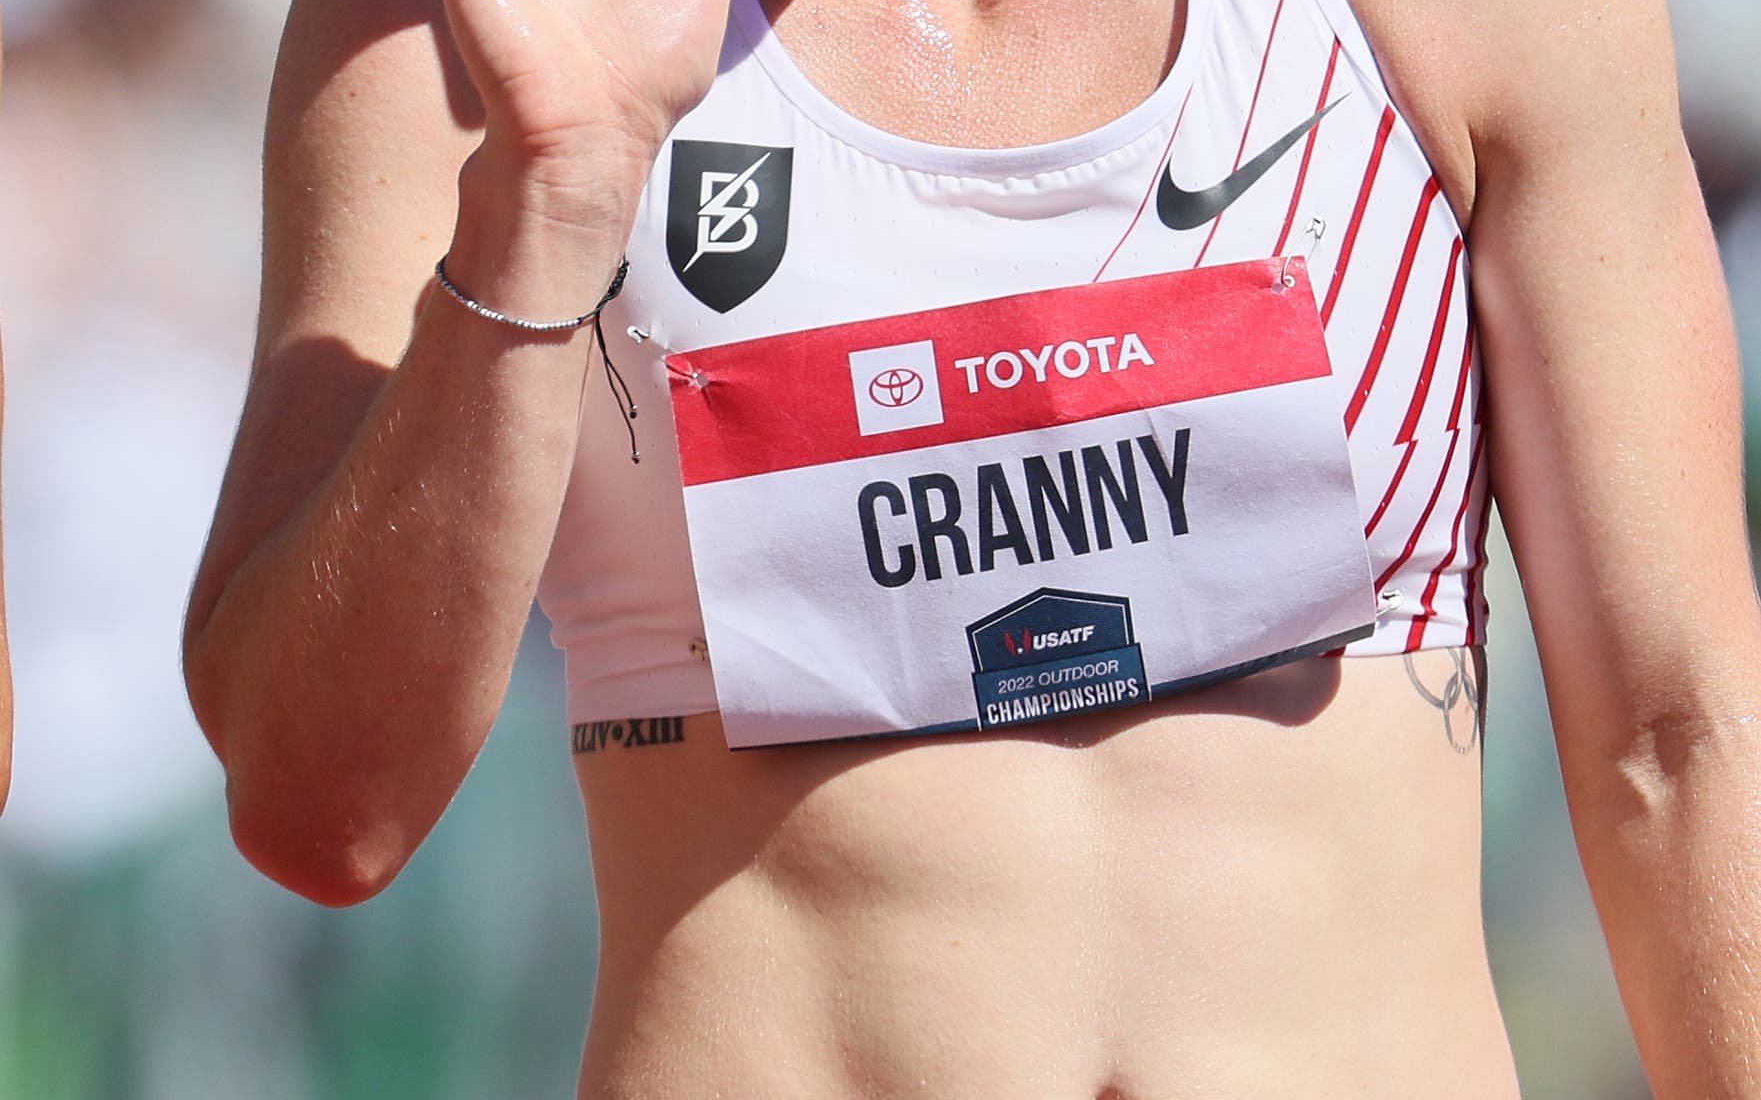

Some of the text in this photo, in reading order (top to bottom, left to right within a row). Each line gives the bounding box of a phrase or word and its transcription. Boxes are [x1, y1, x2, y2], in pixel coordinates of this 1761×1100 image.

[954, 333, 1155, 394] TOYOTA
[857, 428, 1191, 588] CRANNY
[1033, 625, 1095, 650] USATF
[998, 659, 1119, 694] 2022 OUTDOOR
[986, 677, 1140, 725] CHAMPIONSHIPS
